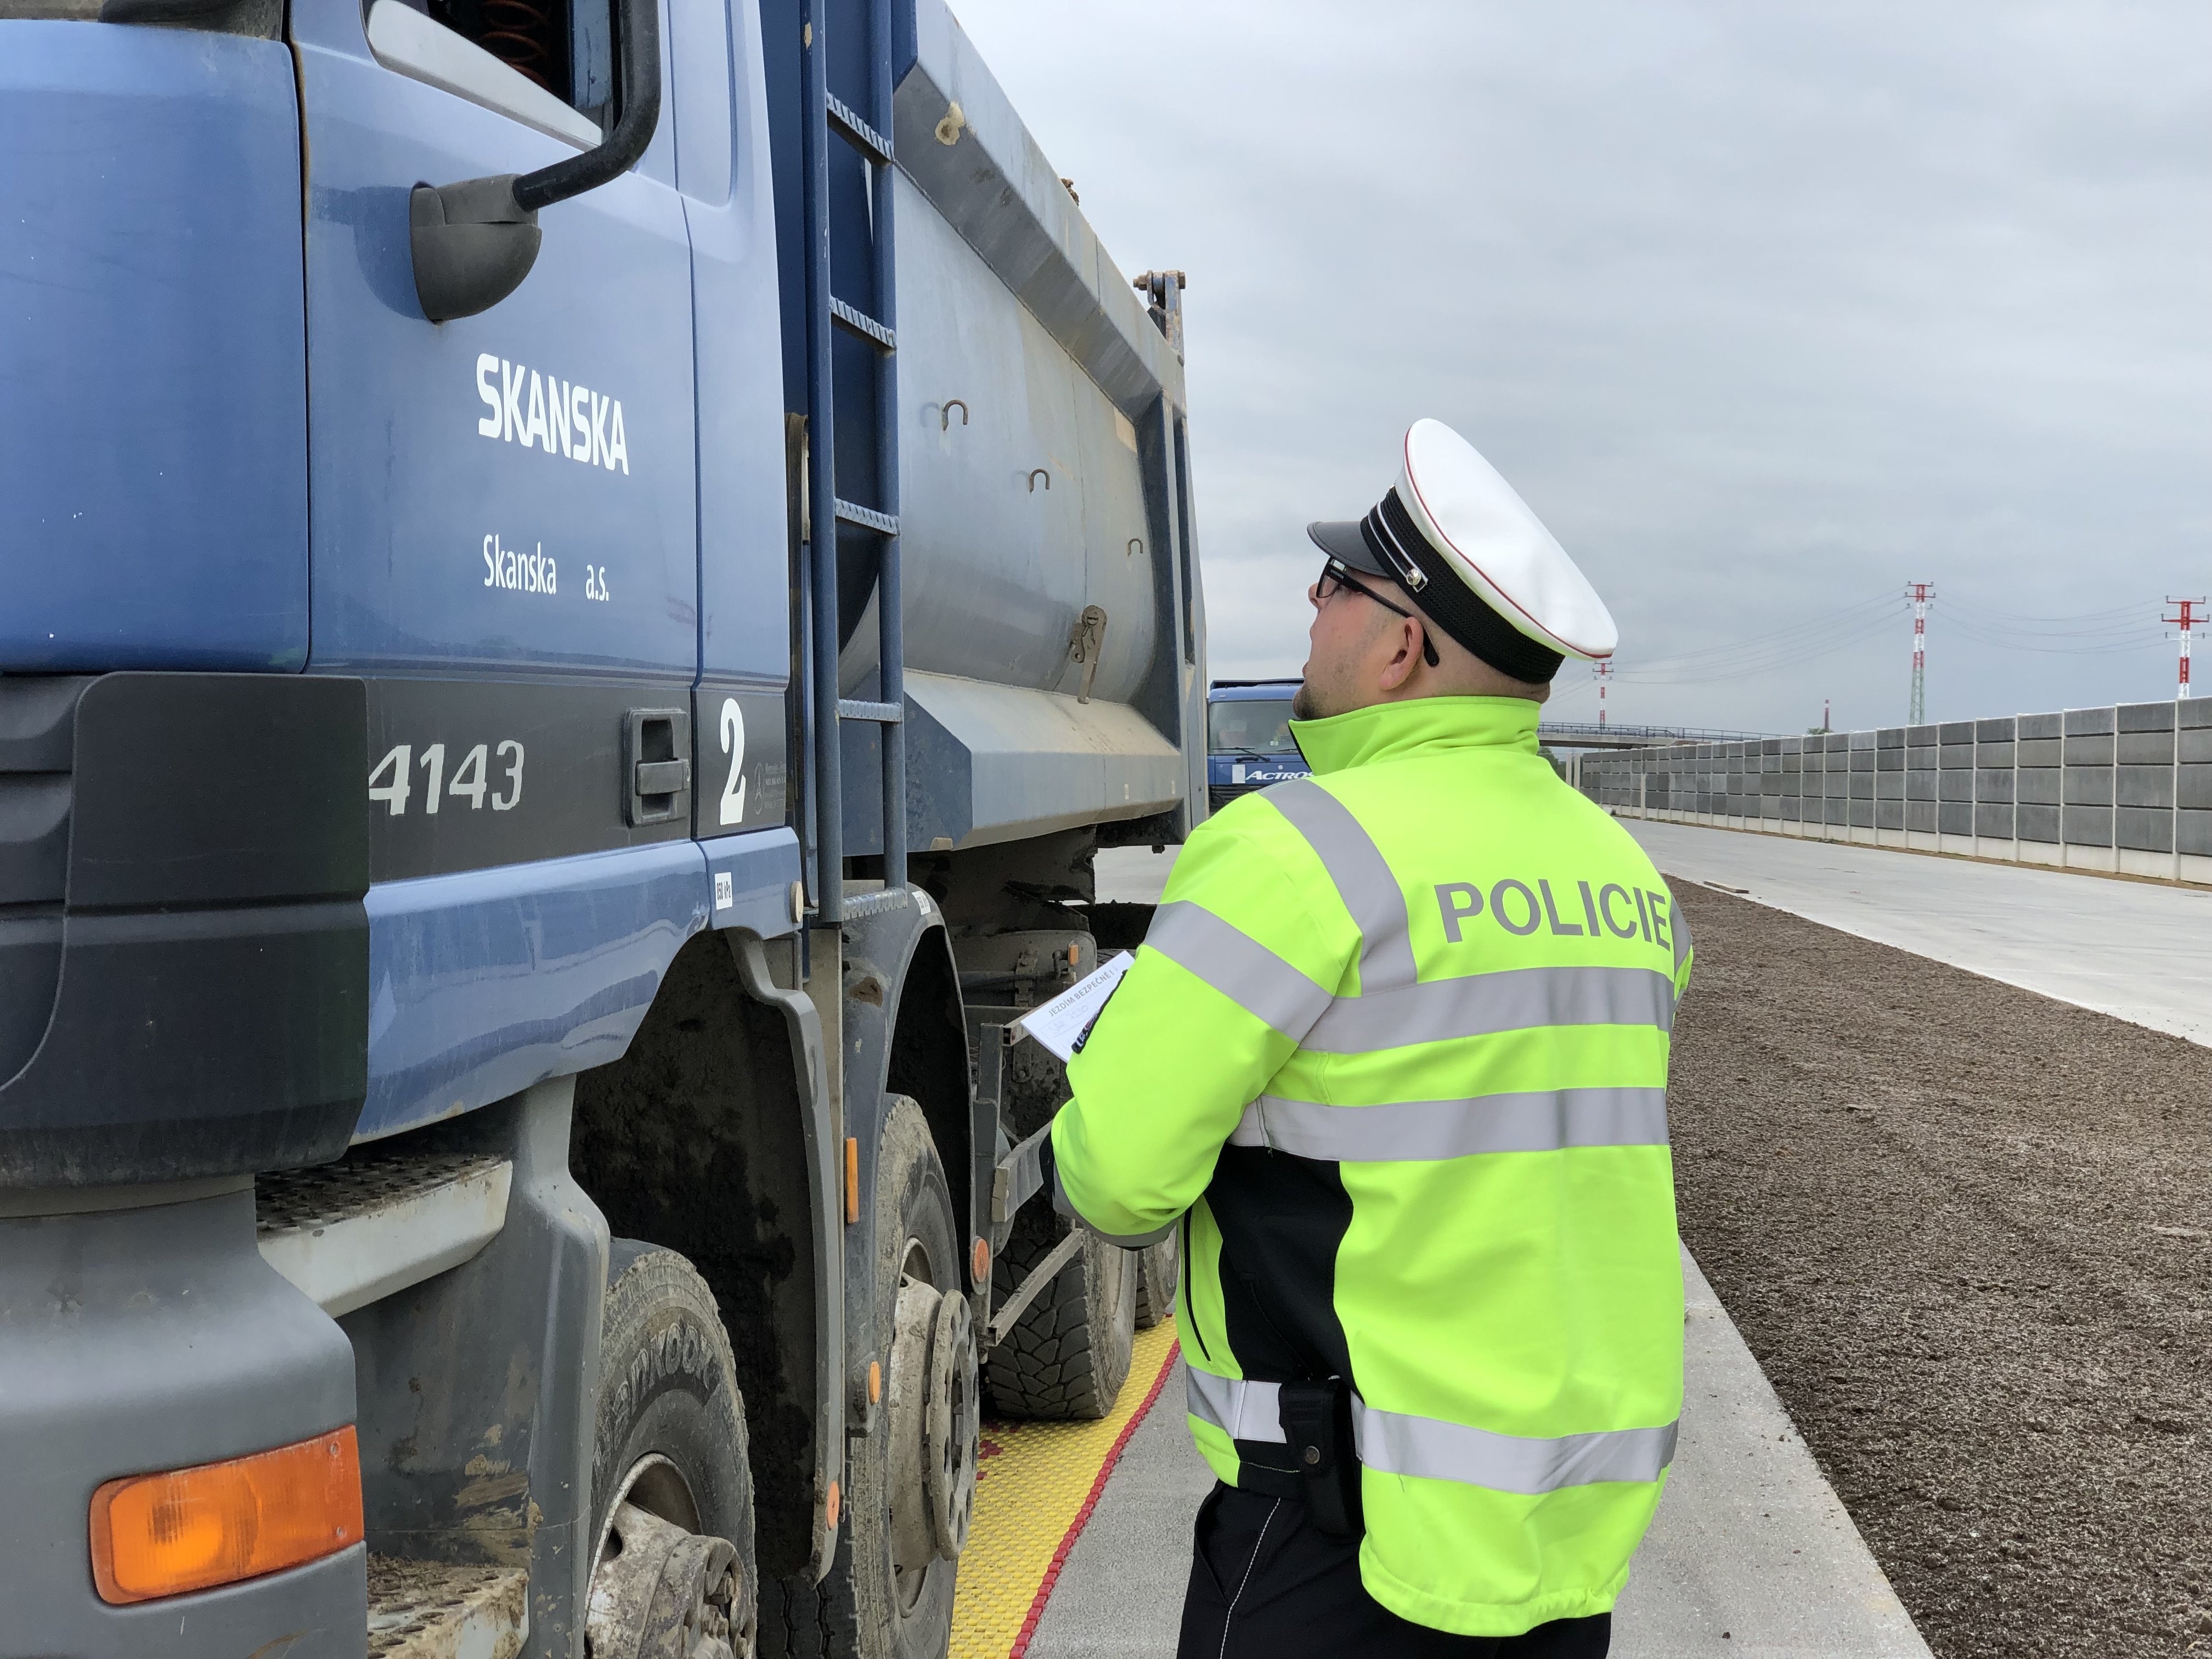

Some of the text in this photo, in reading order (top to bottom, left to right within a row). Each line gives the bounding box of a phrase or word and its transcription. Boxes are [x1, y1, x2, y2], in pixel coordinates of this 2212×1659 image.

[477, 353, 629, 476] SKANSKA
[483, 534, 610, 602] Skanska a.s.
[369, 740, 524, 816] 4143
[720, 698, 746, 826] 2
[1434, 878, 1671, 952] POLICIE
[1048, 997, 1076, 1017] JEZDÍM
